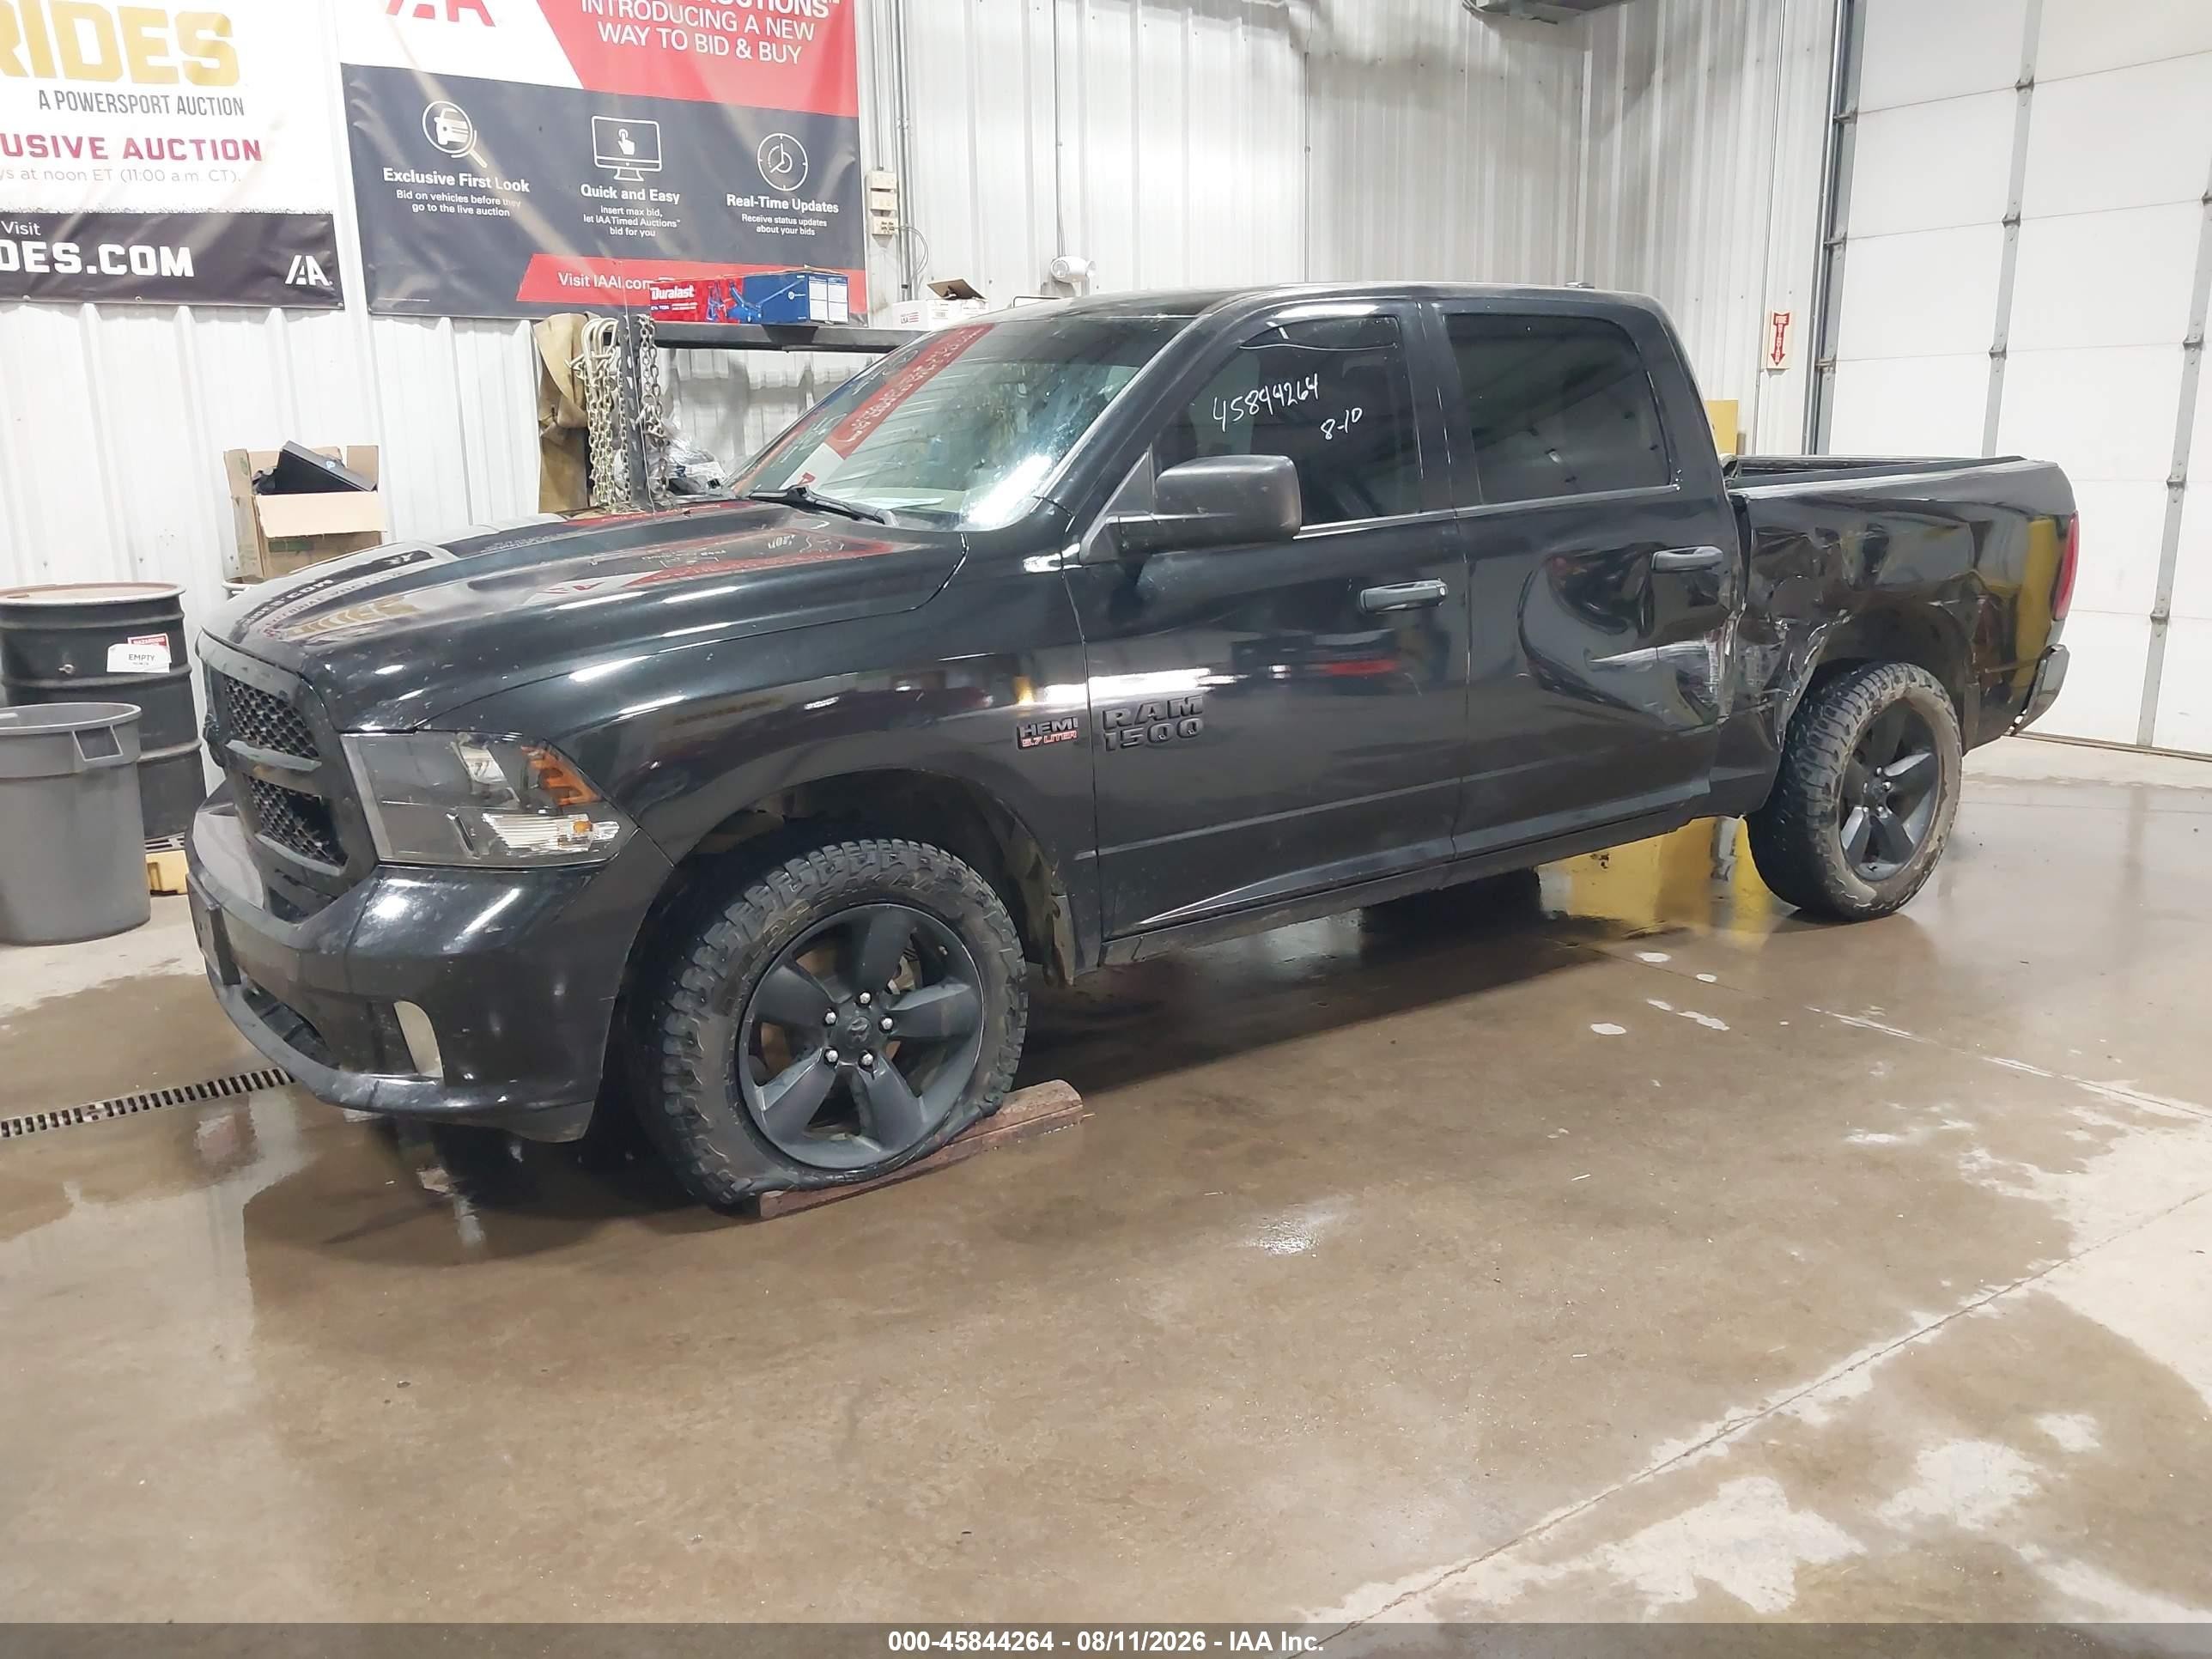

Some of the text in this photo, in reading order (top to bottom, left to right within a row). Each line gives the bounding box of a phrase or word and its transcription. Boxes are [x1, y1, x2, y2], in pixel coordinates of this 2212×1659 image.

[581, 0, 737, 32] INTRODUCING
[744, 14, 760, 35] A
[766, 17, 815, 41] NEW
[598, 21, 802, 64] WAY TO BID & BUY
[39, 89, 245, 116] A POWERSPORT AUCTION
[0, 133, 262, 161] USIVE AUCTION
[21, 168, 38, 180] at
[44, 170, 87, 182] noon
[94, 168, 112, 181] ET
[120, 168, 166, 183] (11:00
[383, 167, 530, 193] Exclusive First Look
[396, 190, 412, 200] Bid
[429, 192, 468, 203] vehicles
[471, 195, 501, 205] before
[580, 183, 680, 205] Quick and Easy
[726, 193, 839, 213] Real-Time Updates
[412, 204, 425, 213] go
[440, 204, 455, 213] the
[457, 205, 474, 214] live
[476, 207, 510, 216] auction
[600, 205, 624, 215] Insert
[647, 209, 663, 217] bid,
[2, 221, 41, 236] Visit
[741, 214, 827, 228] Receive status updates
[610, 227, 656, 238] bid for you
[757, 225, 779, 234] about
[799, 227, 816, 236] bids
[0, 239, 195, 276] DES.COM
[557, 271, 591, 288] Visit
[650, 284, 695, 301] Duralast
[1103, 696, 1203, 729] RAM
[1017, 717, 1079, 738] HEMI
[1104, 718, 1203, 751] 1500
[1044, 731, 1077, 744] LITER
